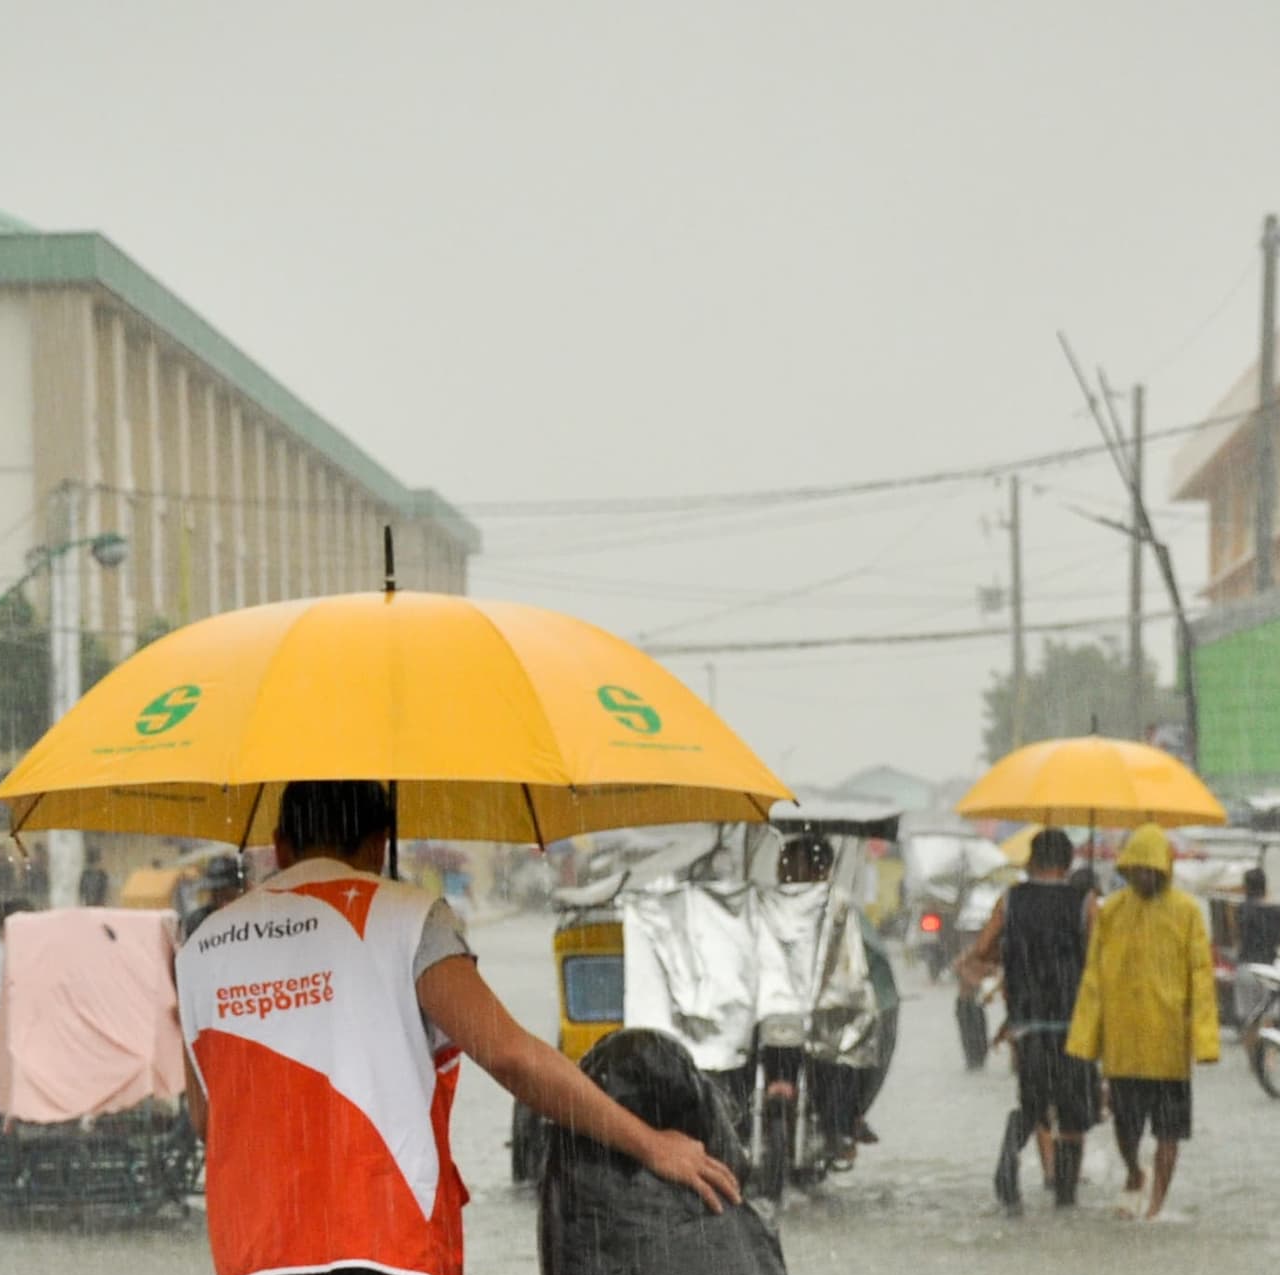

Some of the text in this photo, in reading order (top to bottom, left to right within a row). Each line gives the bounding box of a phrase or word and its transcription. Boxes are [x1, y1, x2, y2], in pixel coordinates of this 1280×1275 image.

[254, 918, 318, 938] Vision
[218, 971, 332, 999] emergency
[218, 987, 333, 1018] response
